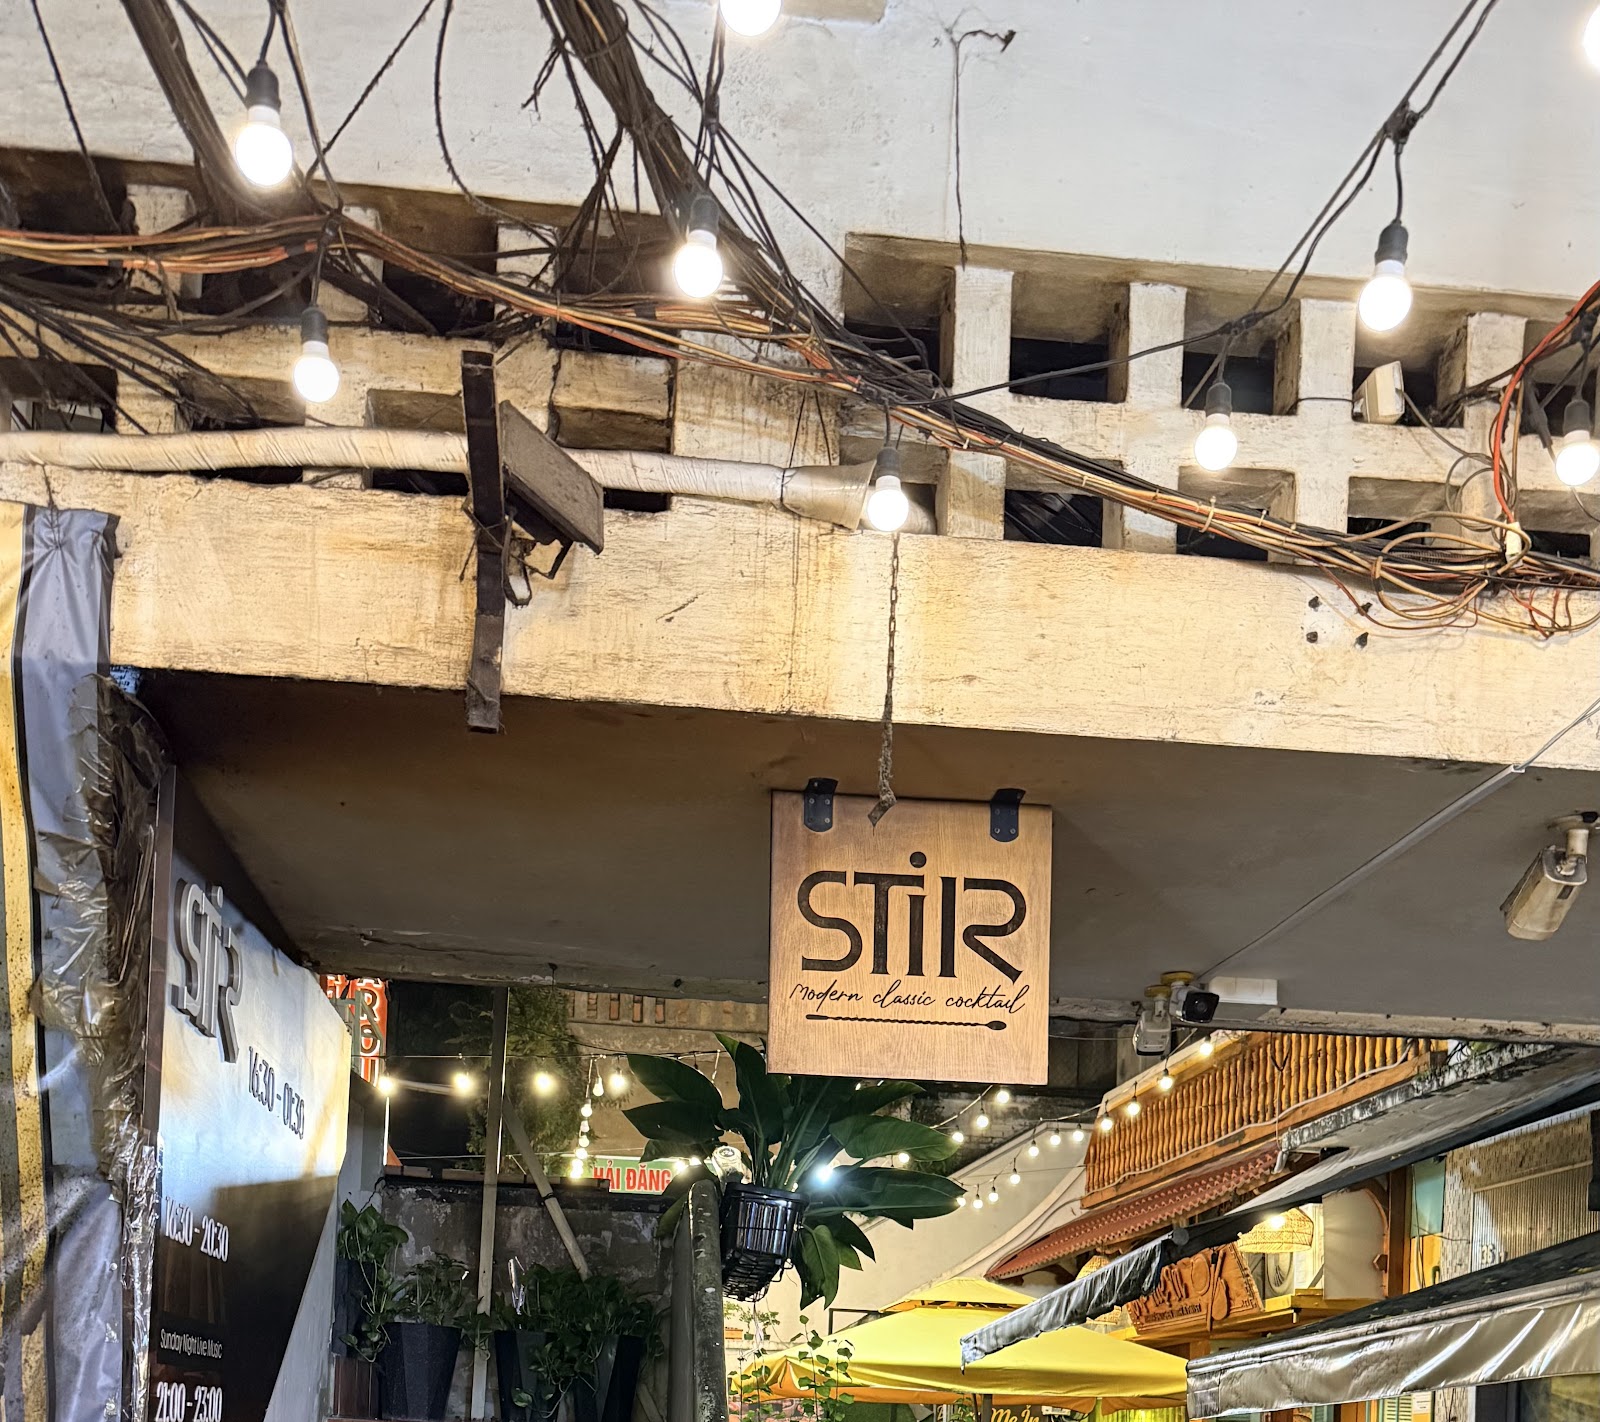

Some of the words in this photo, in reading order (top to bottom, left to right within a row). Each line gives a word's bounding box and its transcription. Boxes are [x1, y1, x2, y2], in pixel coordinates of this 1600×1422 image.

[873, 979, 936, 1009] classic
[945, 984, 1030, 1014] cocktail
[249, 1046, 275, 1112] 16:30
[283, 1082, 305, 1140] 01:30
[165, 1197, 194, 1247] 16:30
[201, 1215, 229, 1262] 20:30
[160, 1328, 183, 1354] Sunday
[183, 1334, 197, 1356] Night
[197, 1336, 207, 1356] Live
[207, 1339, 222, 1358] Music
